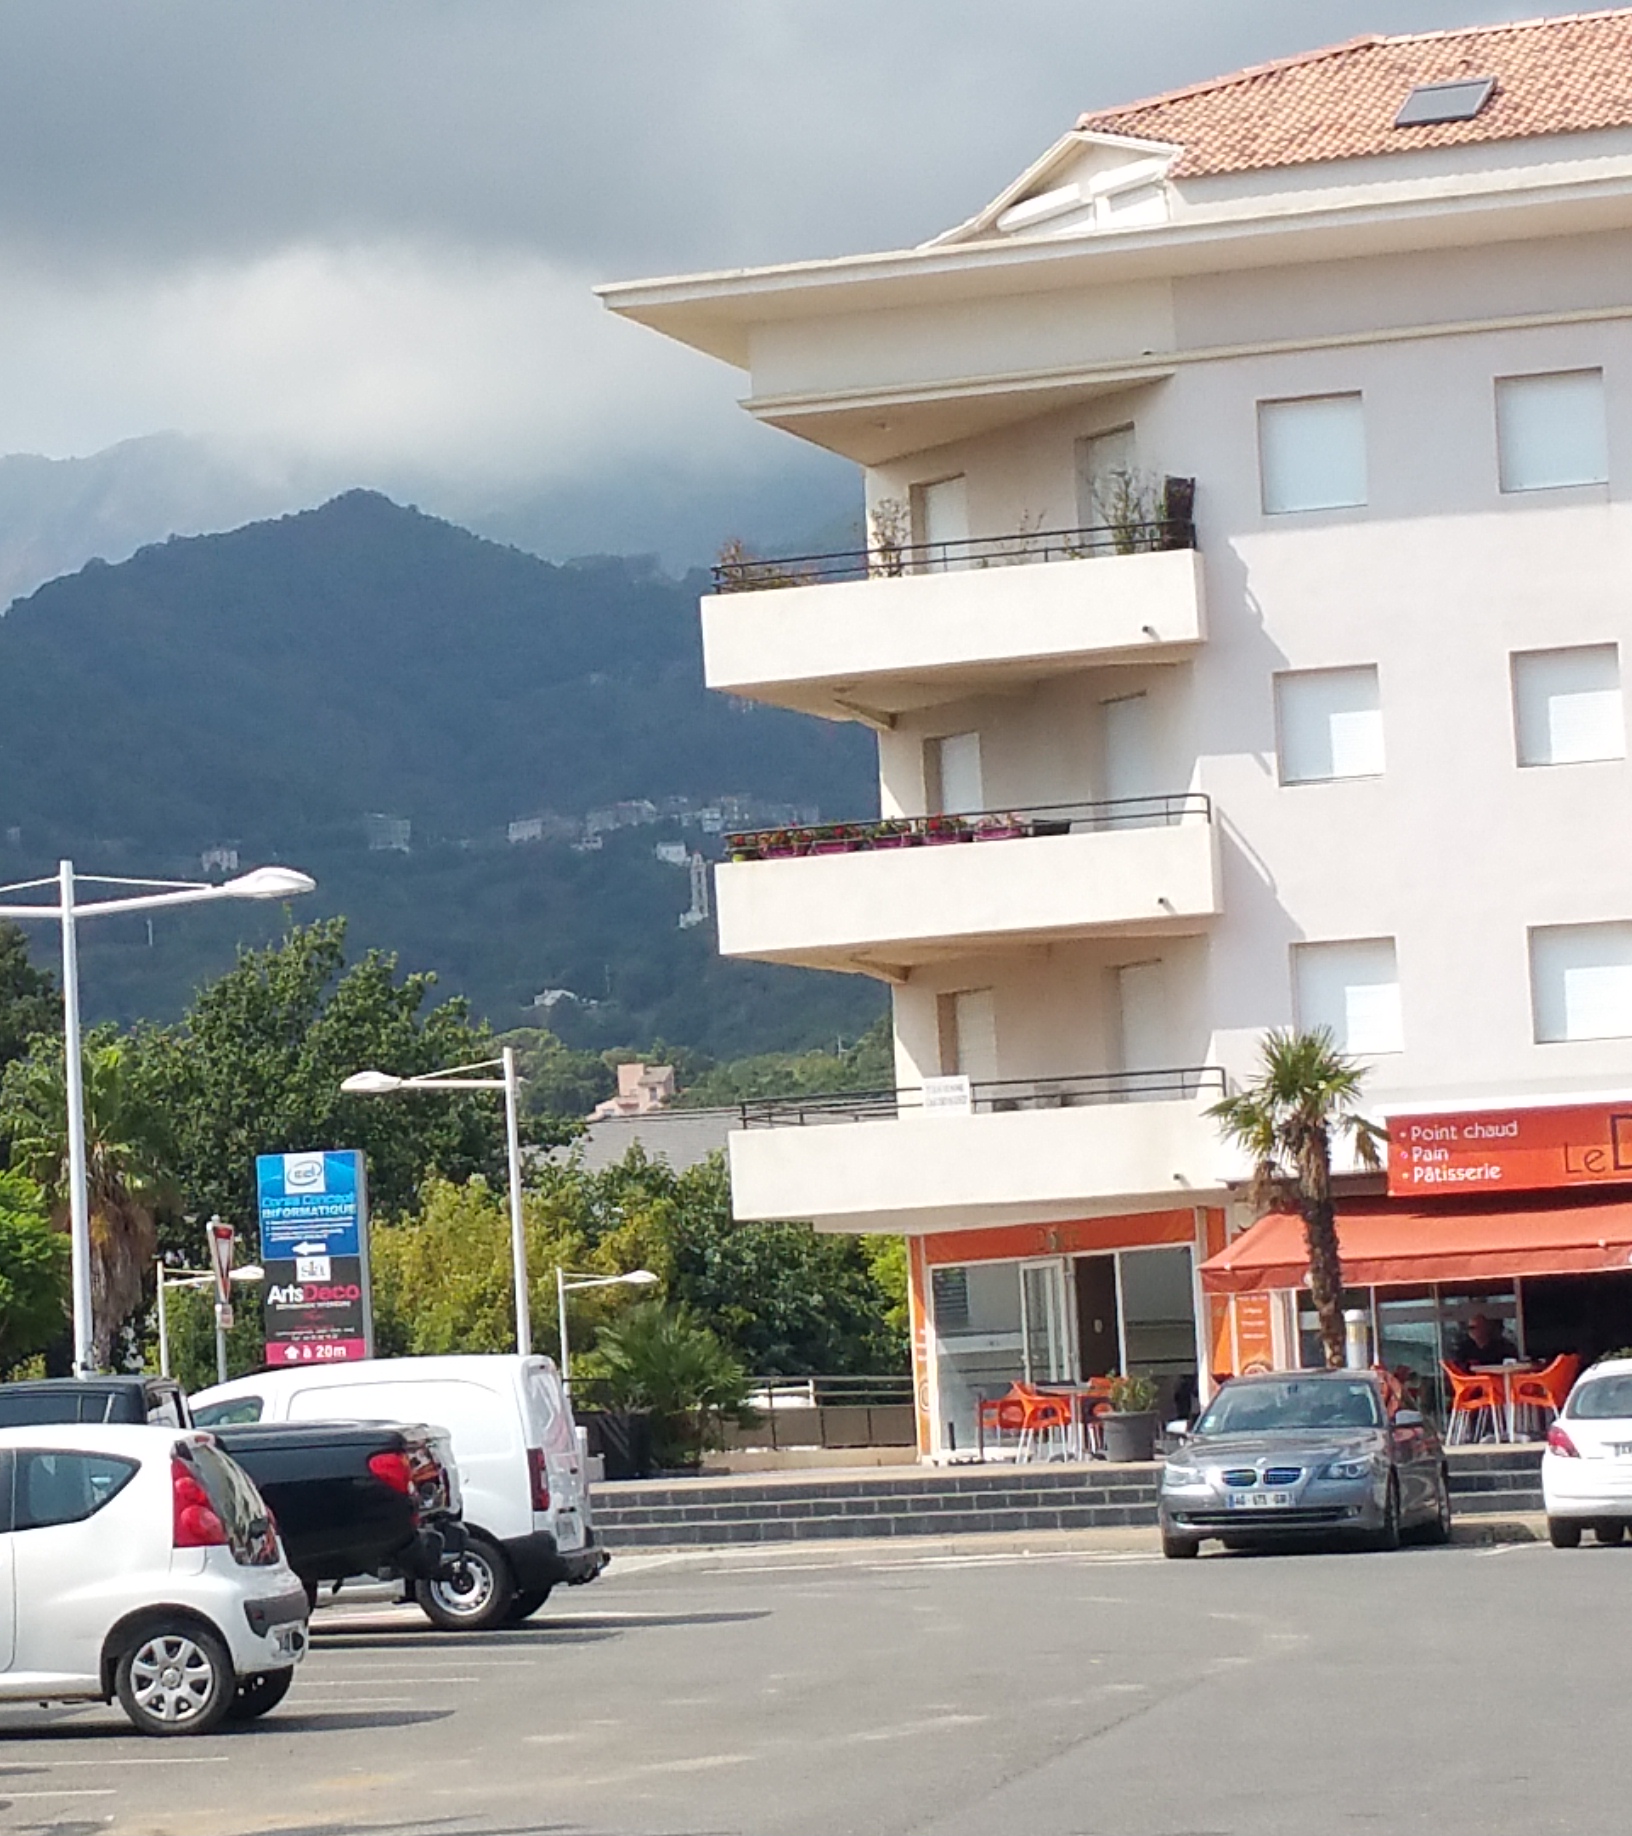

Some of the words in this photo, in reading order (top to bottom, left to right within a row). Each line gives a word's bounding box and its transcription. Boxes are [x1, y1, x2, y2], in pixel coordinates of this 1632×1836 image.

[1411, 1124, 1458, 1141] Point
[1463, 1120, 1518, 1139] chaud
[1412, 1145, 1449, 1162] Pain
[1414, 1163, 1502, 1183] Pâtisserie
[303, 1192, 355, 1206] Concept
[262, 1203, 357, 1219] INFORMATIQUE
[302, 1344, 313, 1358] à
[316, 1344, 348, 1359] 20m
